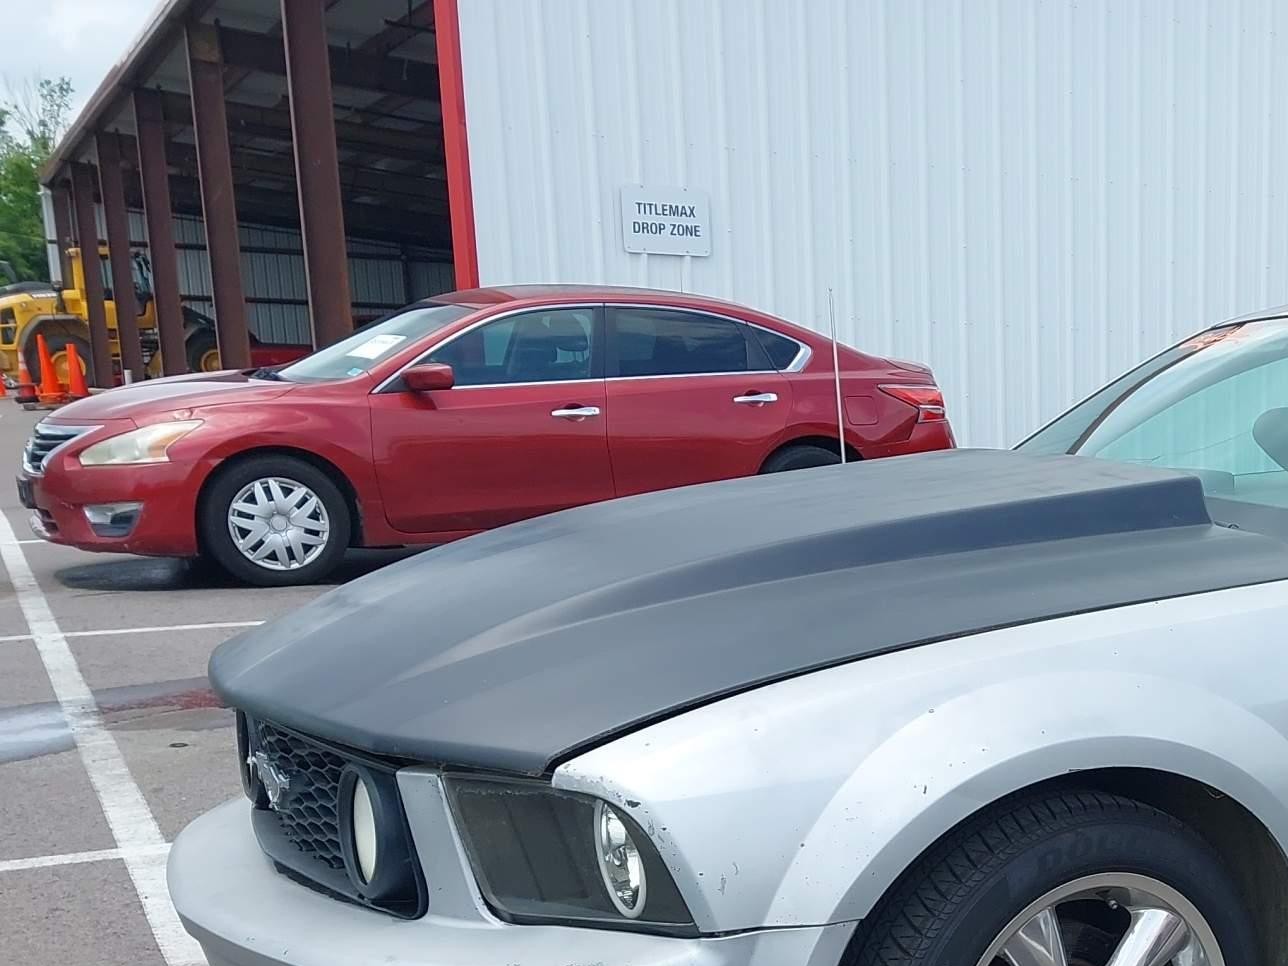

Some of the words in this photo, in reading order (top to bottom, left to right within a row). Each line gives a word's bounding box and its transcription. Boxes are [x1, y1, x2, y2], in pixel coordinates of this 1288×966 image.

[635, 202, 696, 218] TITLEMAX
[633, 221, 666, 235] DROP
[669, 223, 701, 237] ZONE
